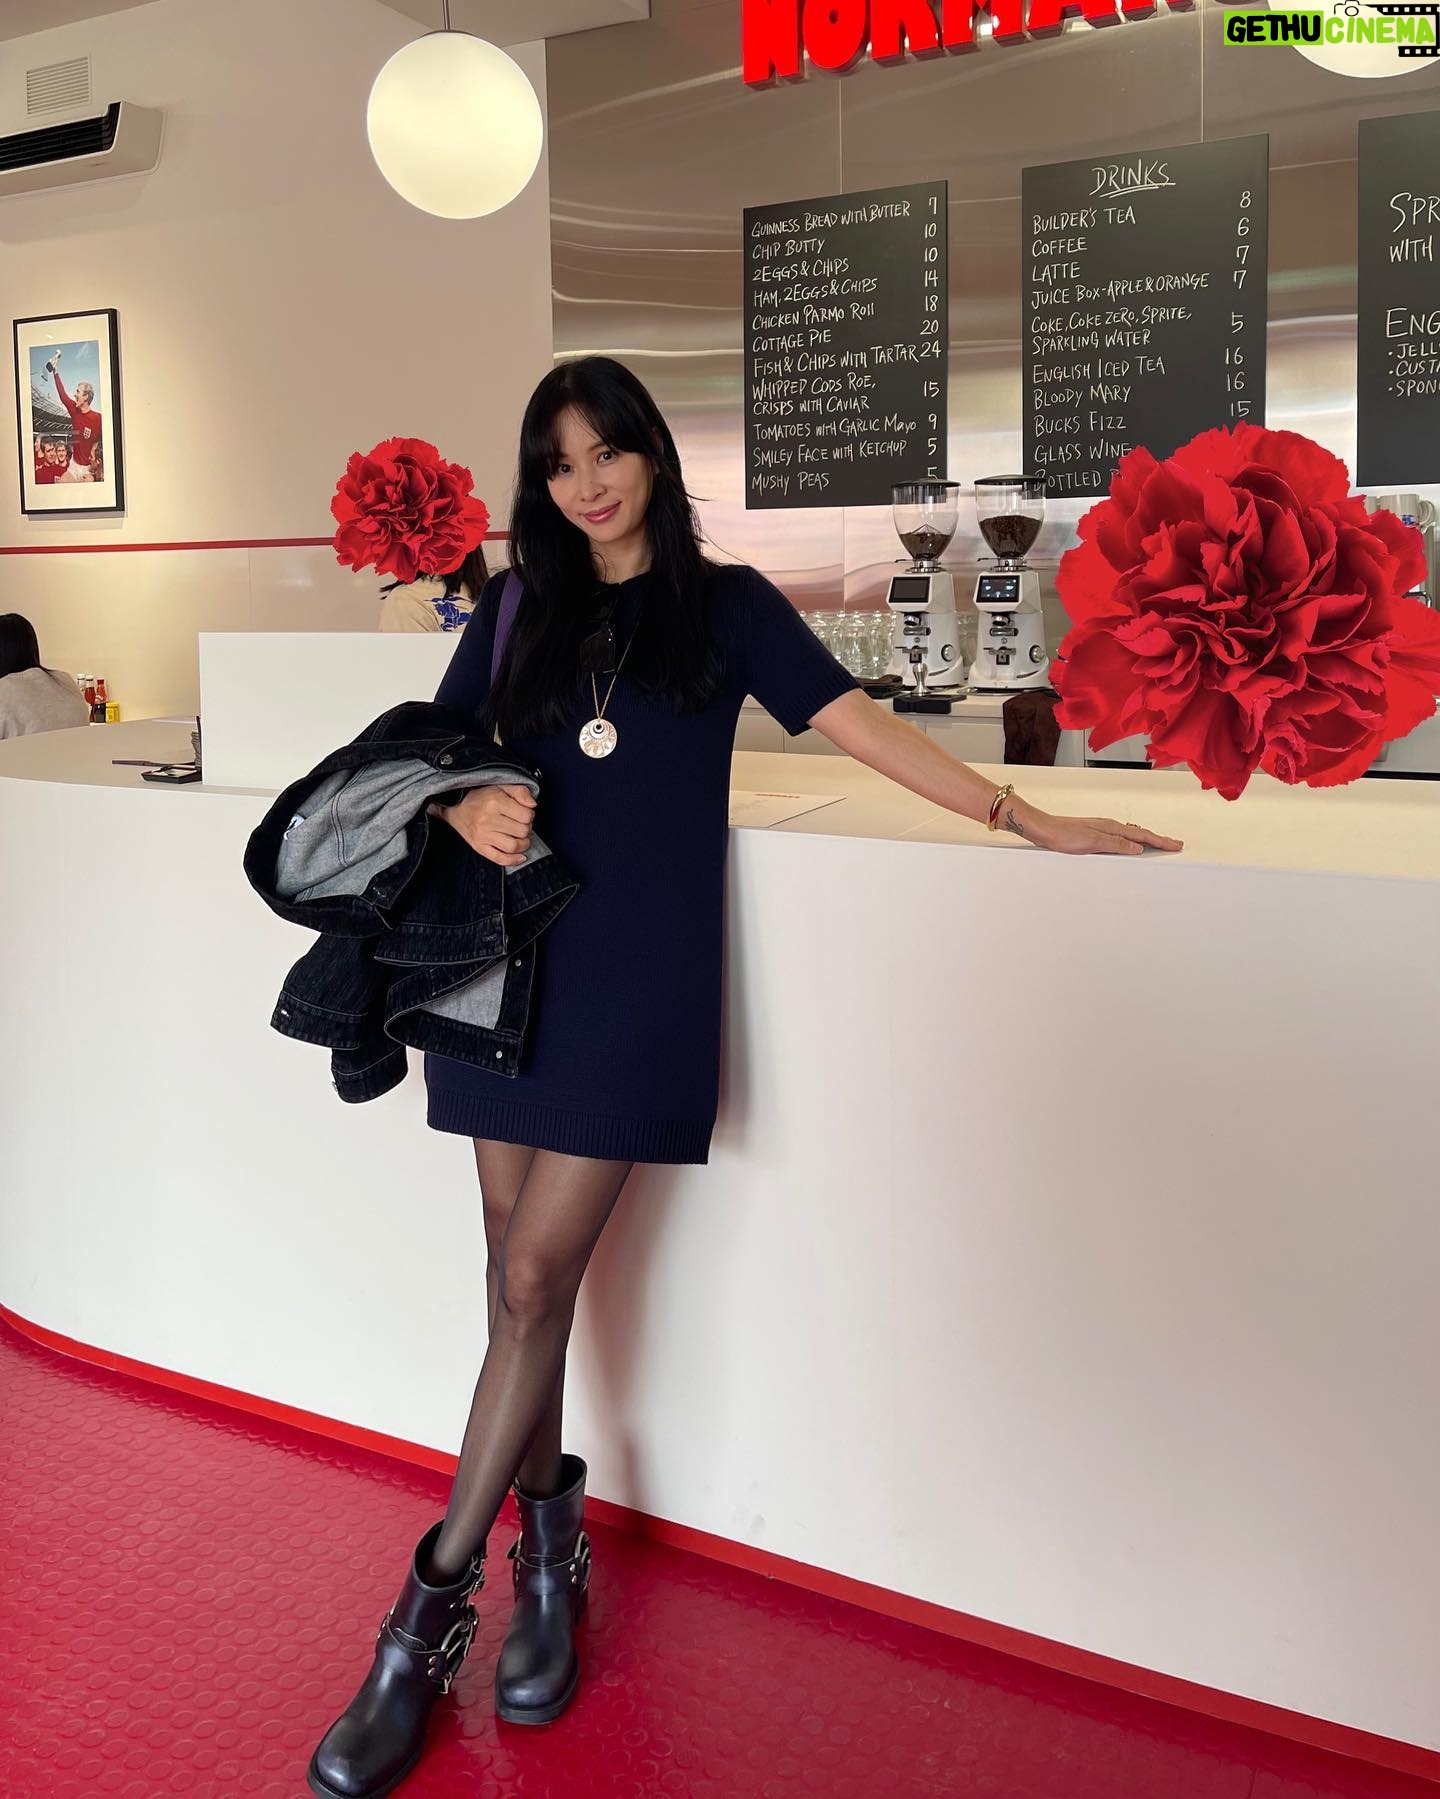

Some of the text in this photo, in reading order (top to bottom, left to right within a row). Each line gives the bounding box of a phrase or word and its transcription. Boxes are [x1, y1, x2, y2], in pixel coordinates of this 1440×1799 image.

[1089, 159, 1171, 196] DRINKS
[928, 196, 937, 215] 7
[1239, 190, 1251, 208] 8
[751, 218, 800, 238] GUINNESS
[804, 212, 838, 232] BREAD
[869, 200, 911, 222] BUTTER
[1103, 205, 1136, 225] TEA
[924, 222, 937, 239] 10
[1237, 217, 1250, 236] 6
[752, 238, 826, 260] CHIP BUTTY
[924, 247, 938, 262] 10
[1032, 236, 1088, 257] COFFEE
[1236, 245, 1250, 265] 7
[1389, 235, 1433, 263] WITH
[924, 269, 939, 287] 14
[1032, 261, 1081, 286] LATTE
[1233, 270, 1247, 289] 7
[925, 294, 939, 312] 18
[1031, 288, 1070, 310] JUICE
[752, 311, 800, 331] CHICKEN
[803, 304, 845, 326] PARMO
[920, 319, 939, 335] 20
[1069, 311, 1101, 330] COKE
[1231, 311, 1245, 334] 5
[752, 329, 832, 353] COTTAGE PIE
[920, 340, 942, 359] 24
[1032, 329, 1151, 356] SPARKLING WATER
[840, 351, 868, 368] WITH
[870, 344, 920, 365] TARTAR
[1225, 347, 1244, 365] 16
[1033, 356, 1166, 384] ENGLISH ICED TEA
[752, 378, 808, 401] WHIPPED
[811, 377, 843, 395] CODS
[923, 380, 940, 398] 15
[1226, 371, 1245, 392] 16
[753, 395, 870, 416] CRISPS WITH CAVIAR
[1033, 382, 1132, 411] BLOODY MARY
[1230, 400, 1251, 417] 15
[753, 422, 811, 442] TOMATOES
[839, 417, 880, 438] GARLIC
[928, 413, 937, 430] 9
[1033, 410, 1127, 438] BUCKS FIZZ
[753, 439, 907, 468] SMILEY FACE WITH KETCHUP
[927, 437, 938, 456] 5
[1034, 443, 1082, 465] GLASS
[752, 471, 831, 496] MUSHY PEAS
